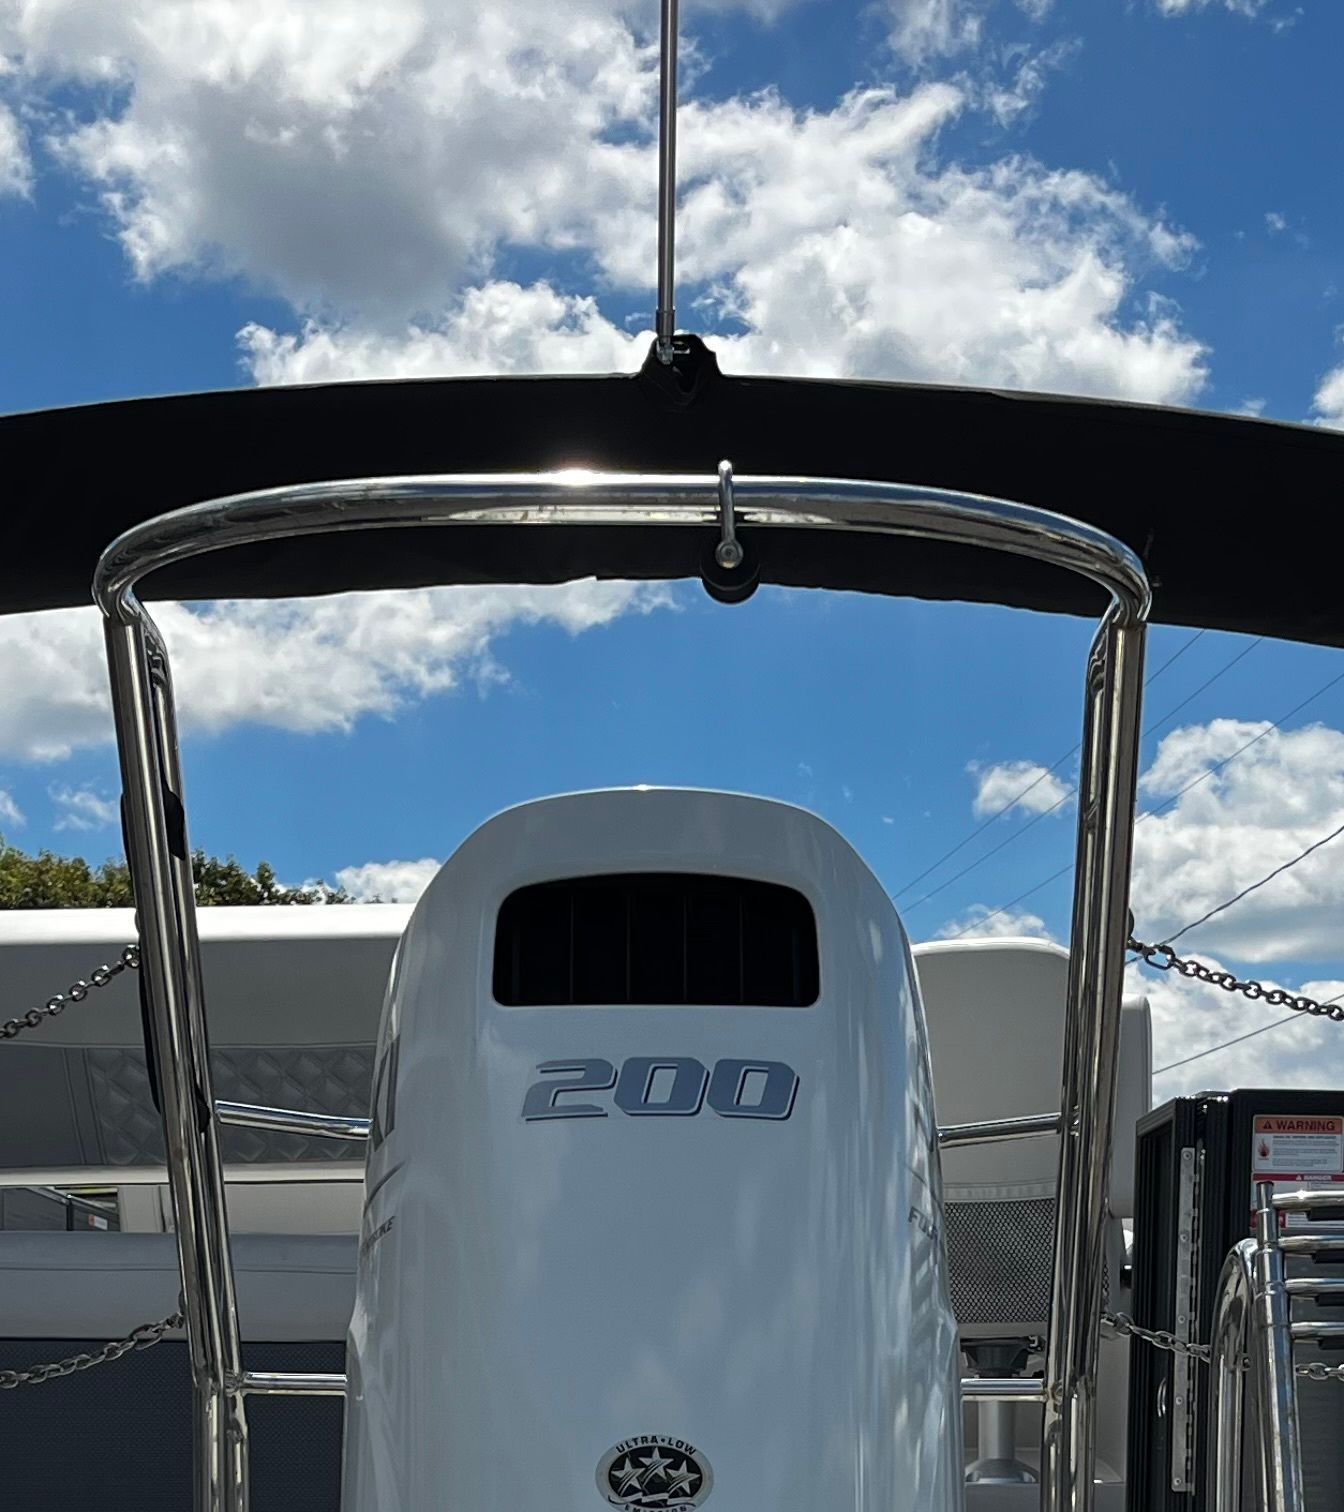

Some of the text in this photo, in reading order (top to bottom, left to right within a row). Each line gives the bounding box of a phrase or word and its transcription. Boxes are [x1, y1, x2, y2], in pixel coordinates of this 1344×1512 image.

[521, 1057, 800, 1121] 200
[1276, 1120, 1335, 1132] WARNING
[616, 1435, 696, 1455] ULTRA LOW
